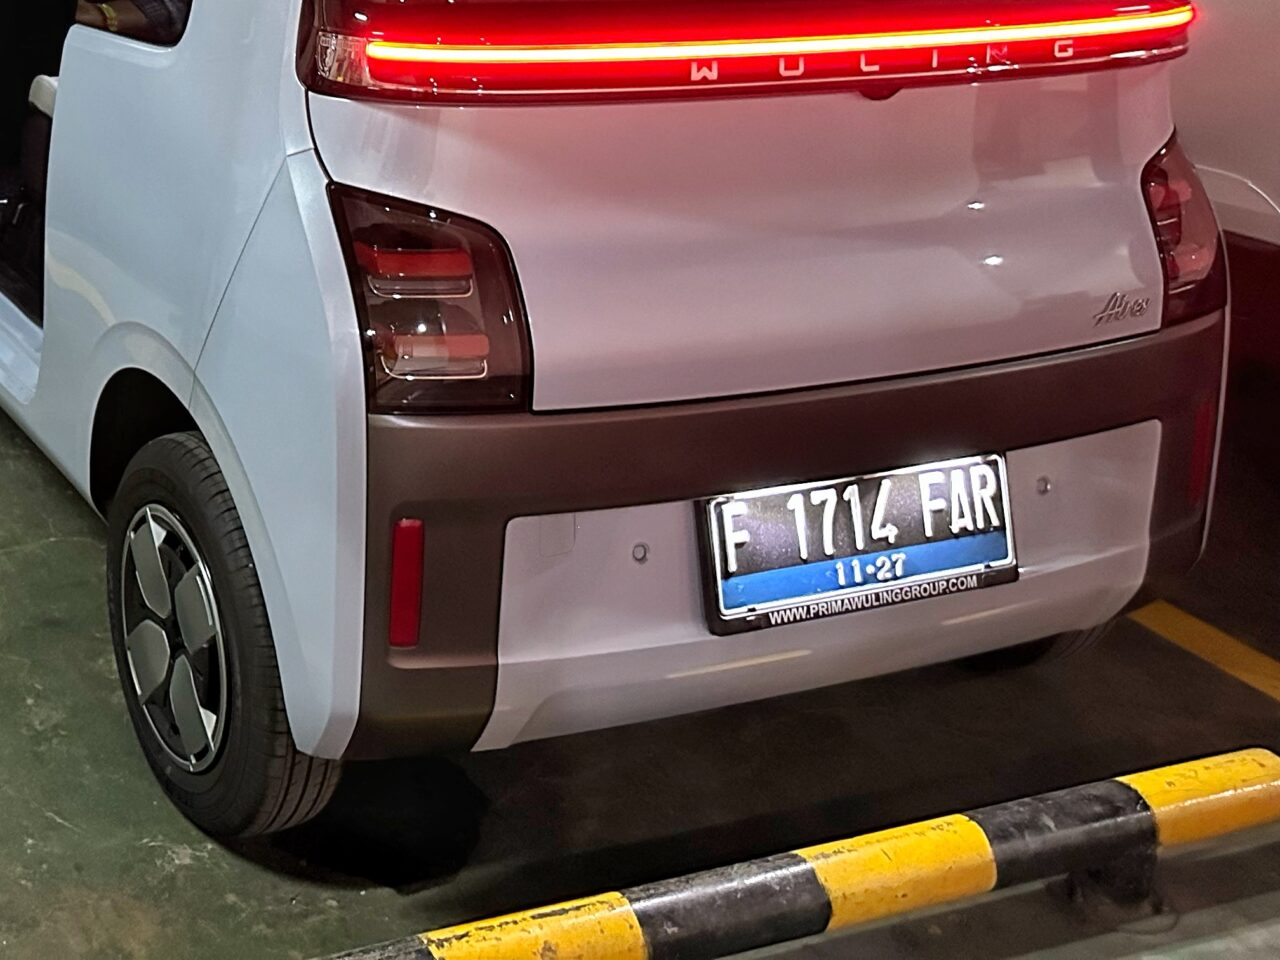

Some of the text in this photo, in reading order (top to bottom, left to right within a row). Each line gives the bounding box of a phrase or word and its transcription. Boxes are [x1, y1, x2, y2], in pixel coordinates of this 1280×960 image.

[691, 40, 1074, 81] WULING
[721, 464, 1000, 573] F 1714 FAR
[768, 575, 979, 626] WWW.PRIMAWULINGGROUP.COM
